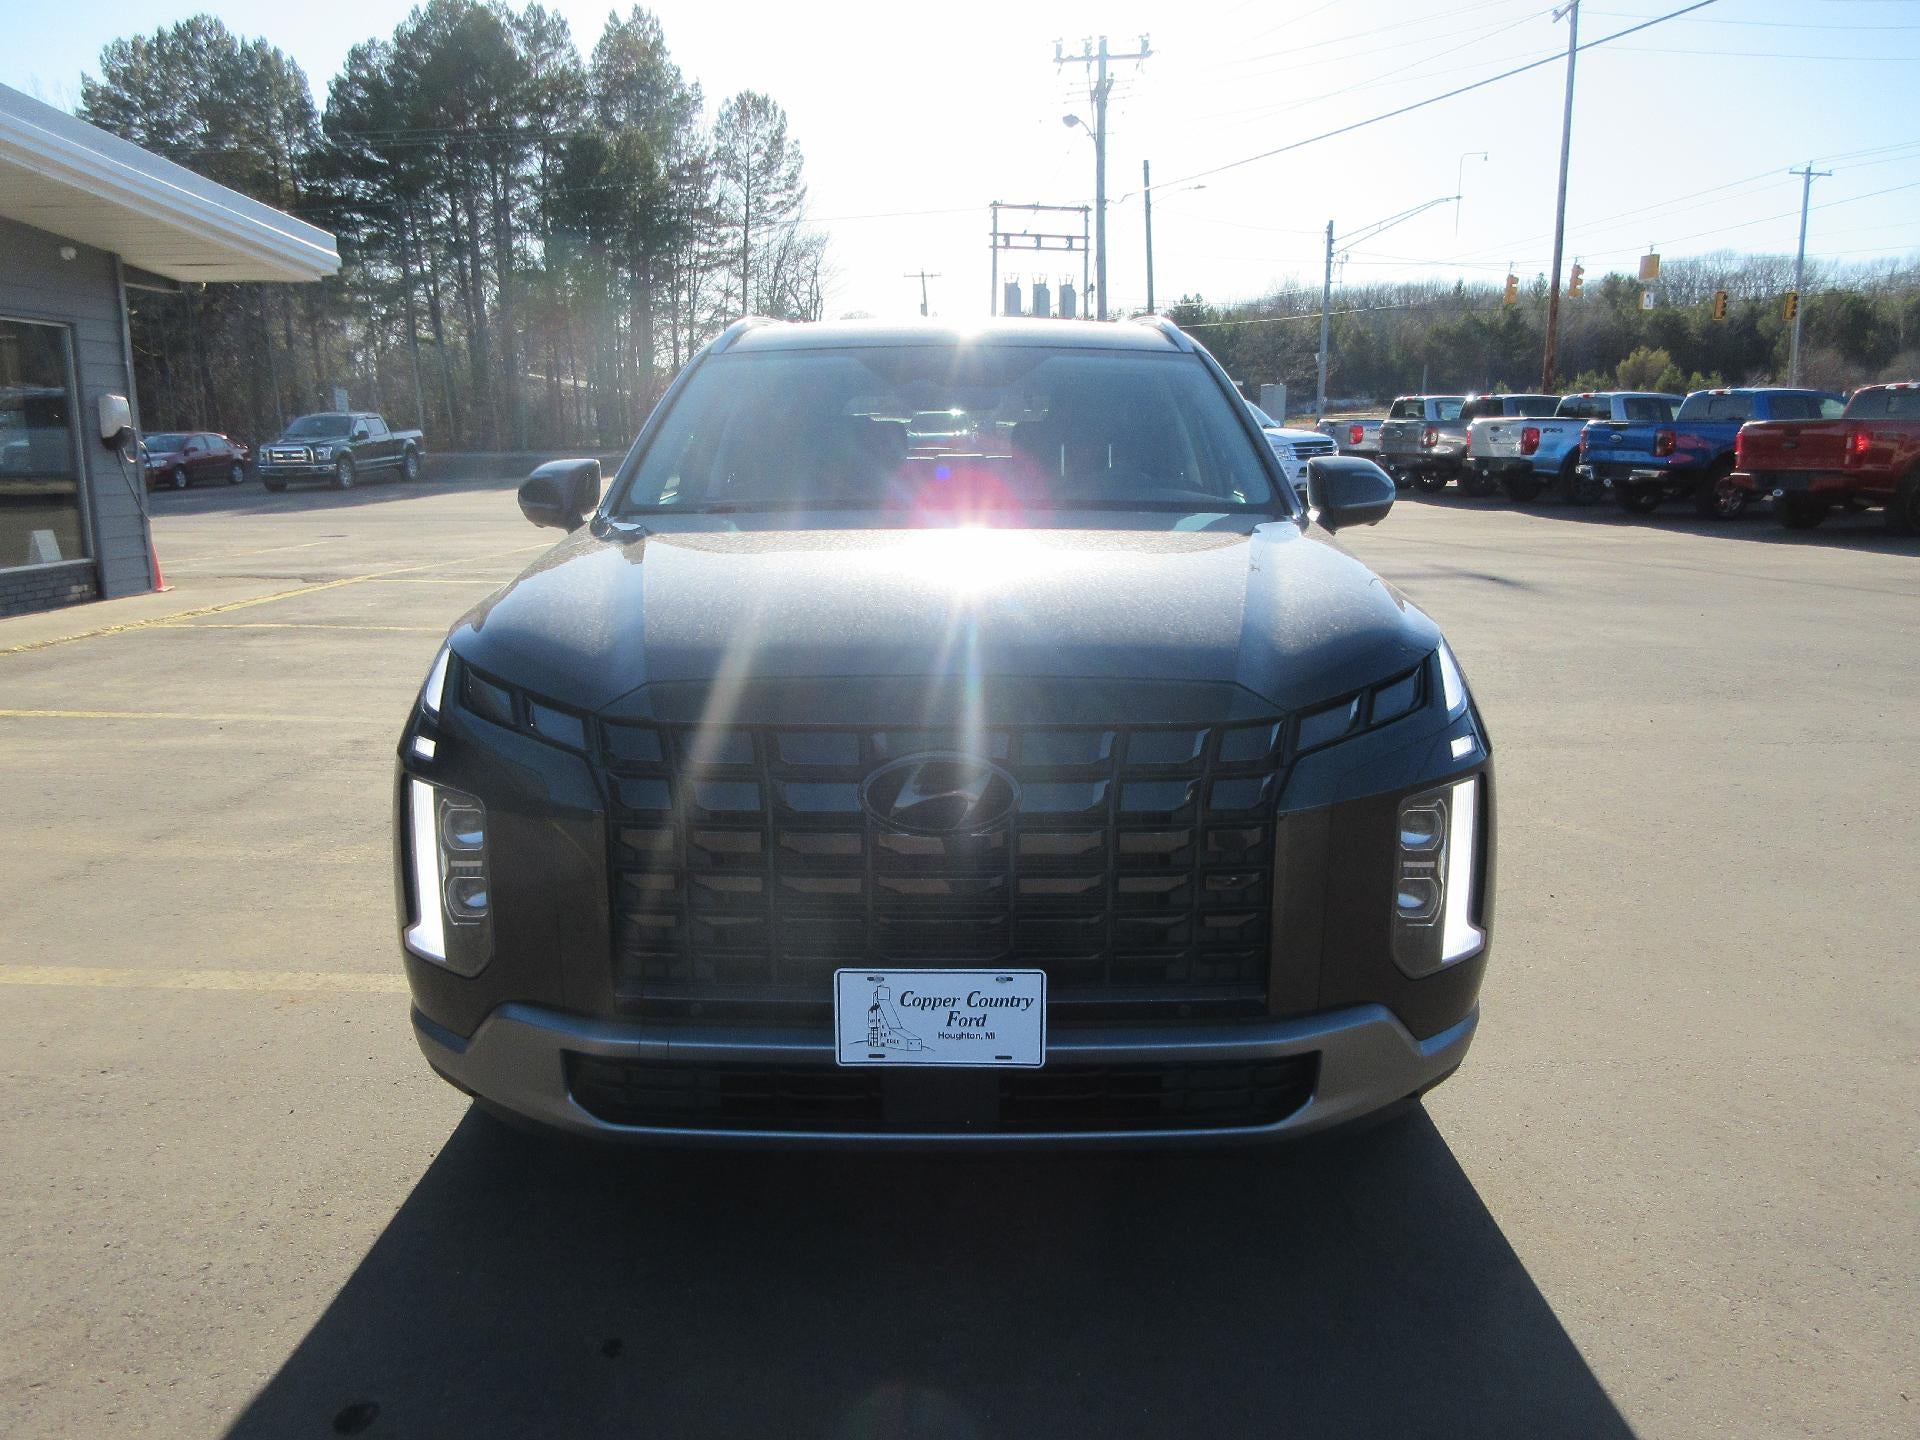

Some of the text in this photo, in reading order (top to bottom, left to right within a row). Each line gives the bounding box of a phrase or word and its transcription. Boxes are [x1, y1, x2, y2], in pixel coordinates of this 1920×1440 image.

[900, 990, 1034, 1012] Copper Country
[946, 1010, 988, 1028] Ford
[938, 1031, 996, 1041] Houghton, MI
